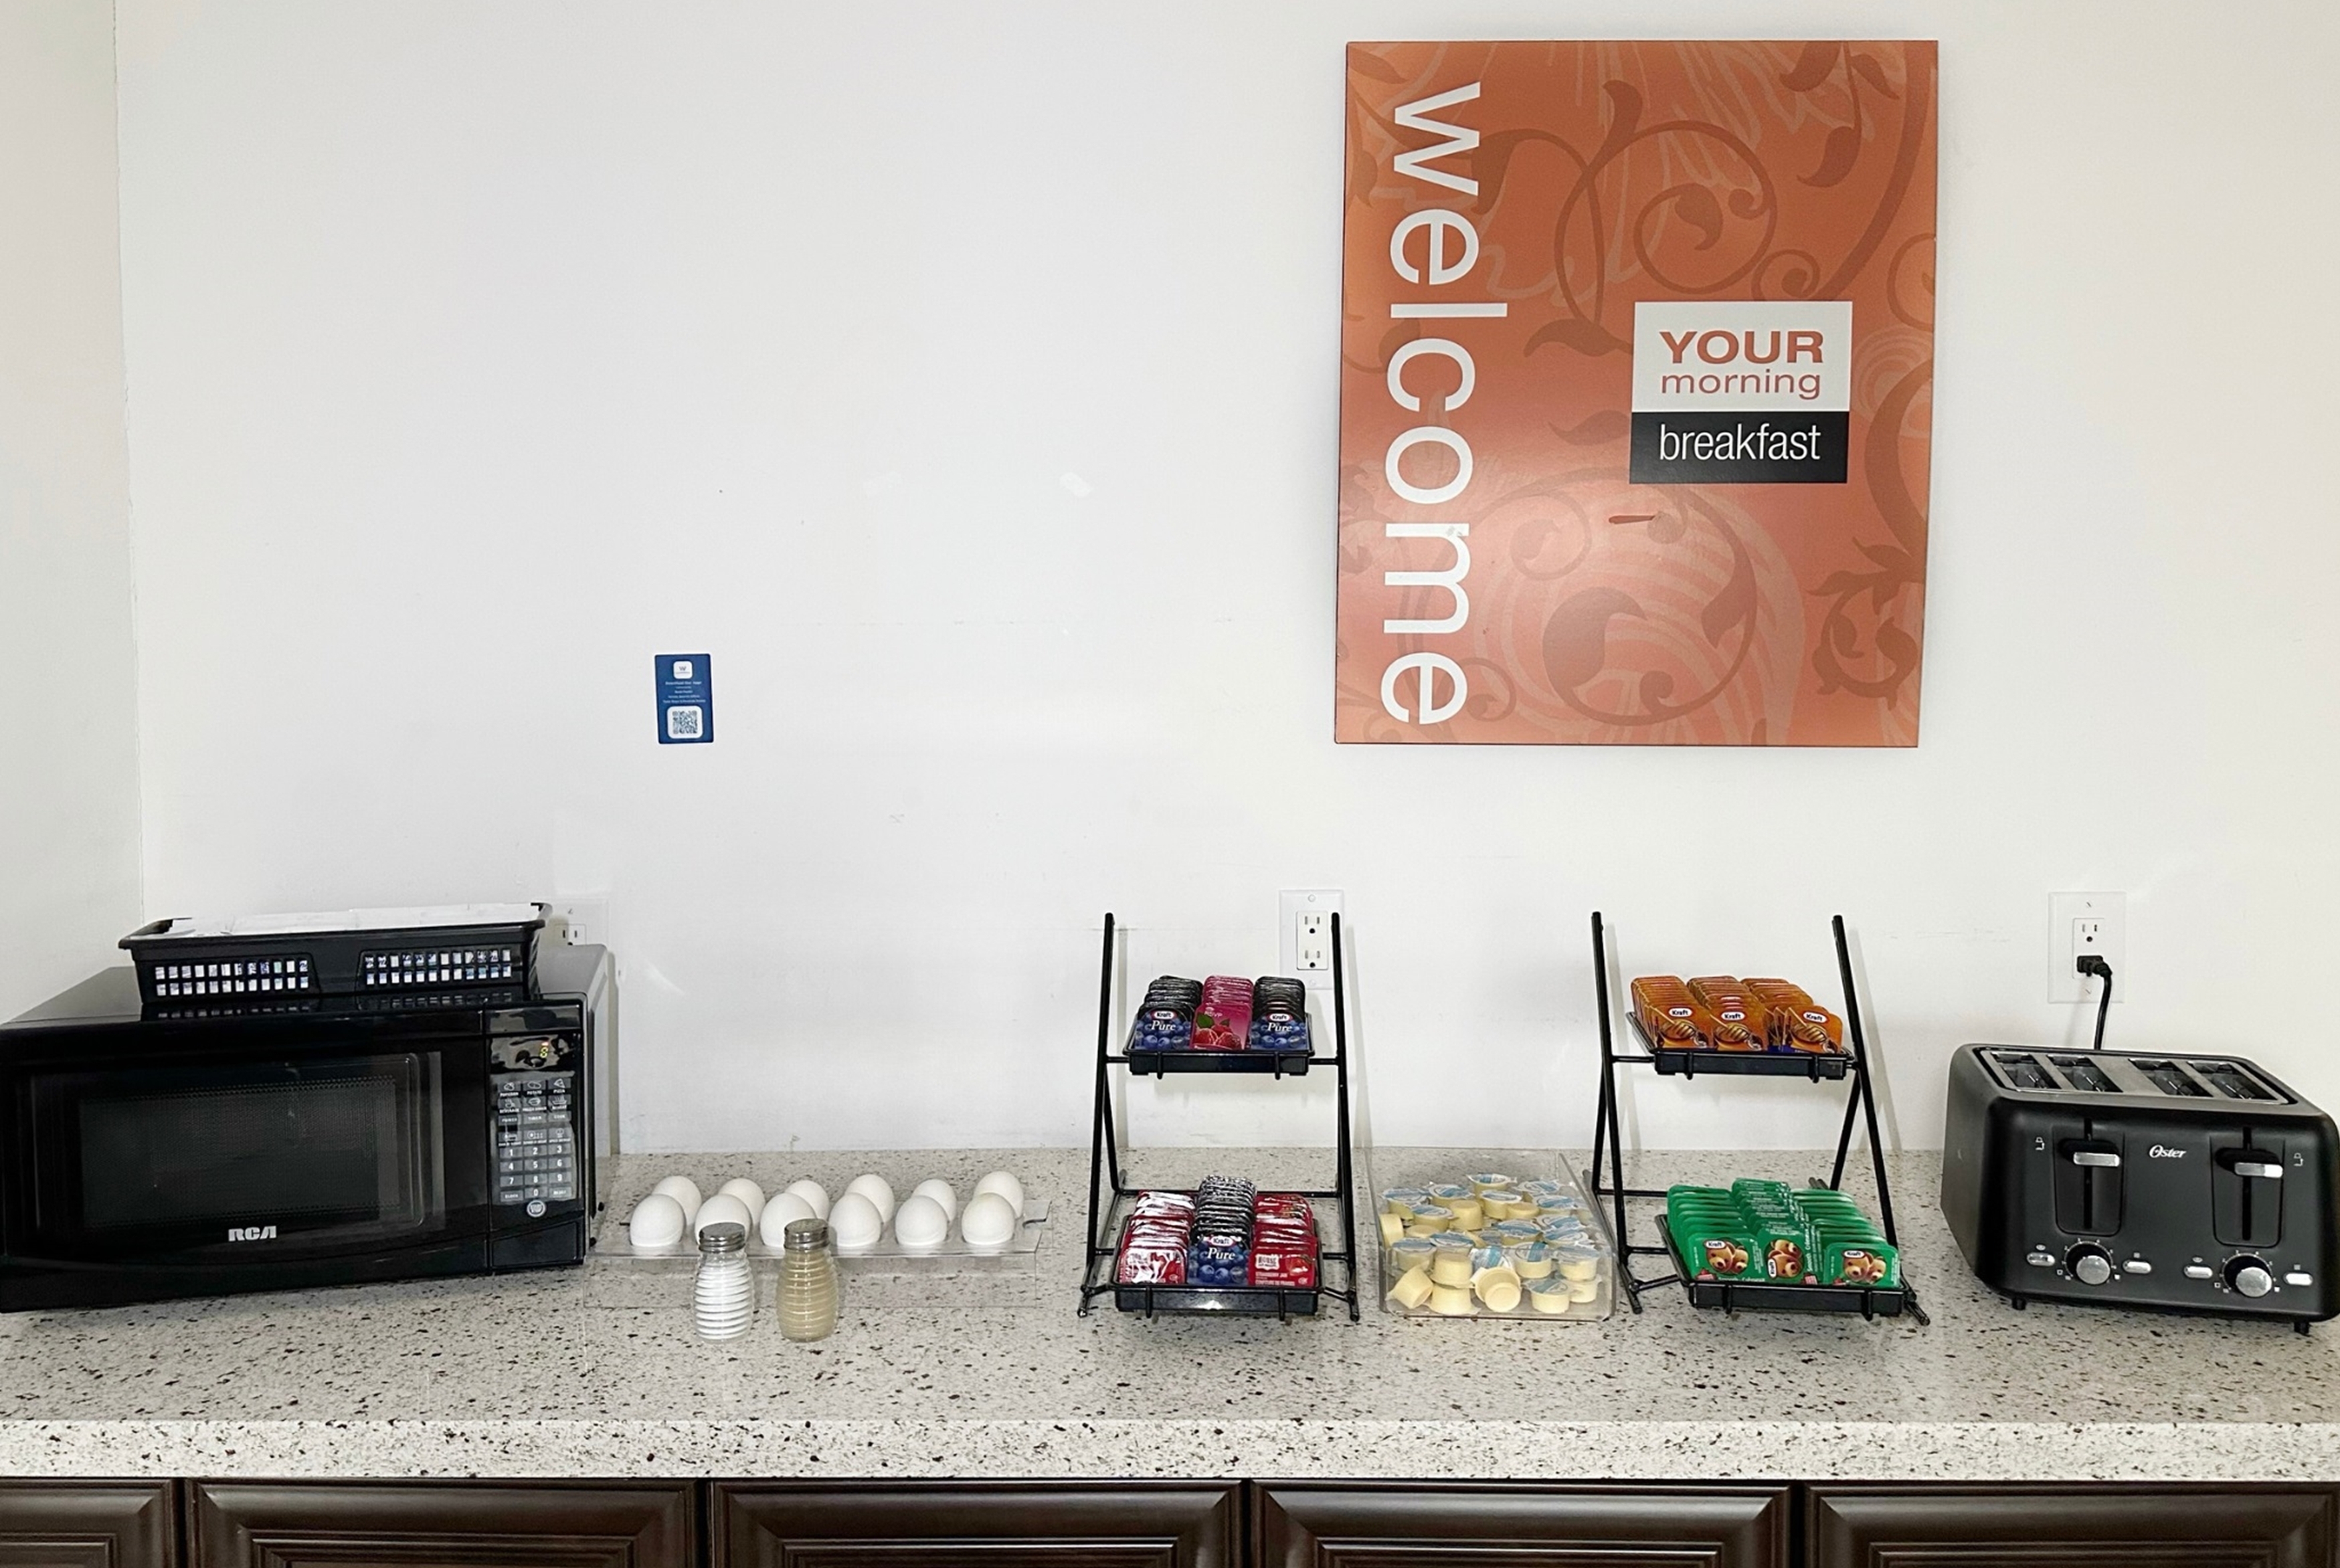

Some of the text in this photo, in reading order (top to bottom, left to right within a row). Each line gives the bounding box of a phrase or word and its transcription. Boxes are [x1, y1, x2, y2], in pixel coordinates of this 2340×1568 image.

[1659, 330, 1824, 365] YOUR
[1661, 369, 1821, 400] morning
[1380, 80, 1508, 726] welcome
[1659, 422, 1821, 460] breakfast
[1724, 1011, 1741, 1019] Kraft
[1806, 1013, 1823, 1021] Kraft
[1152, 1019, 1176, 1031] Pure
[1267, 1022, 1292, 1032] Pure
[509, 1149, 513, 1157] 1
[533, 1147, 538, 1155] 2
[557, 1145, 562, 1153] 3
[2149, 1144, 2187, 1158] Oster
[533, 1161, 538, 1169] 5
[533, 1175, 538, 1183] 8
[557, 1173, 562, 1181] 9
[533, 1189, 538, 1197] 0
[228, 1226, 276, 1242] RCA
[1207, 1247, 1235, 1260] Pure
